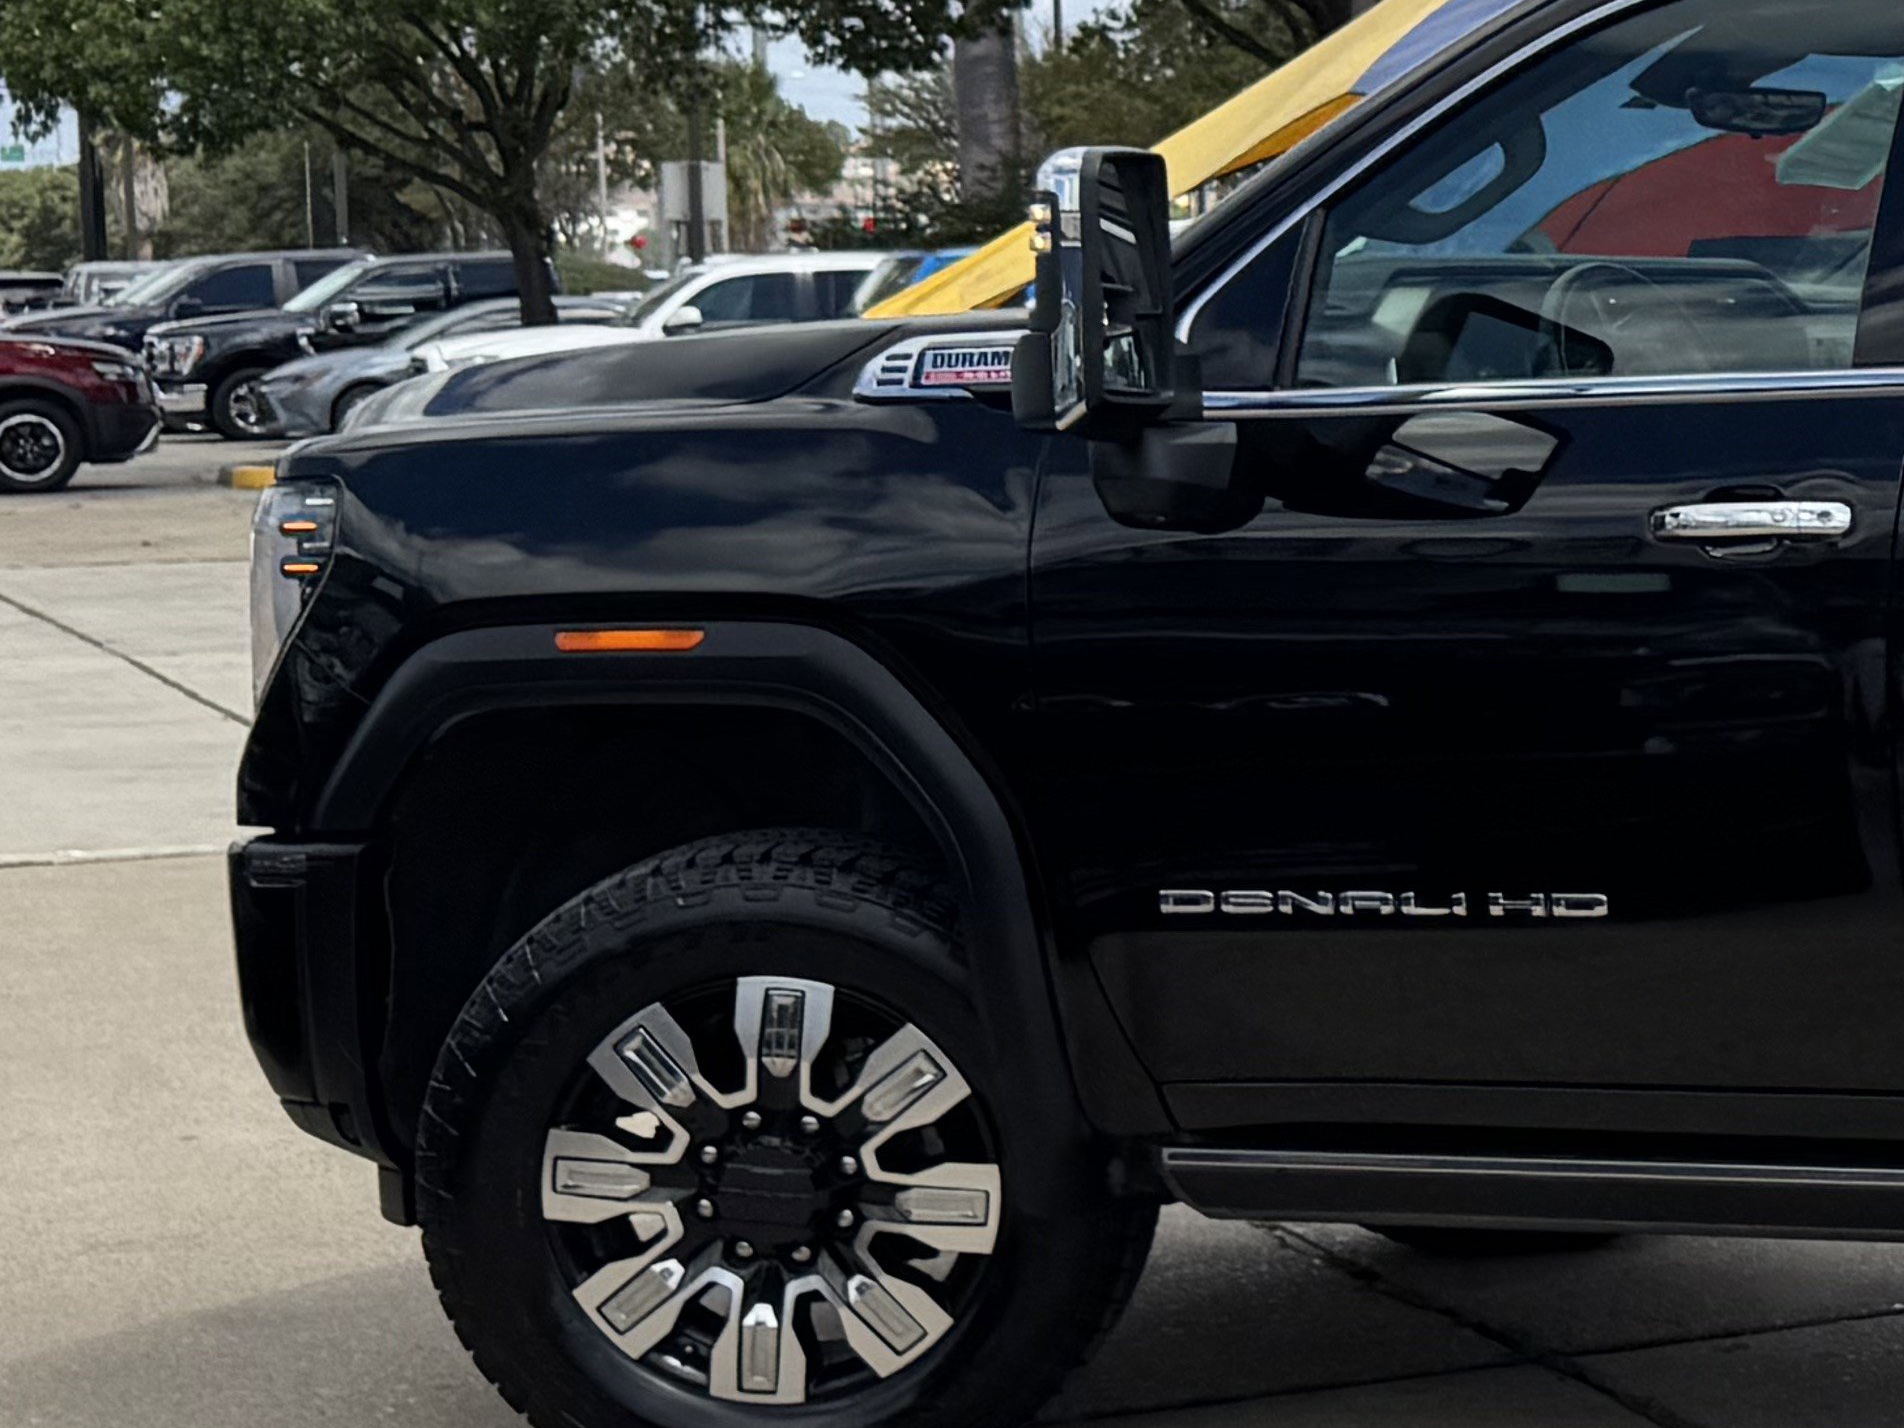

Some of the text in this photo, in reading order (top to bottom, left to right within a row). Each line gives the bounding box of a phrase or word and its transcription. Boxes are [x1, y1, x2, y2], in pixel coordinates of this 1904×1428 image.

[931, 351, 1012, 369] DURAM
[1159, 889, 1609, 918] DENALI HD
